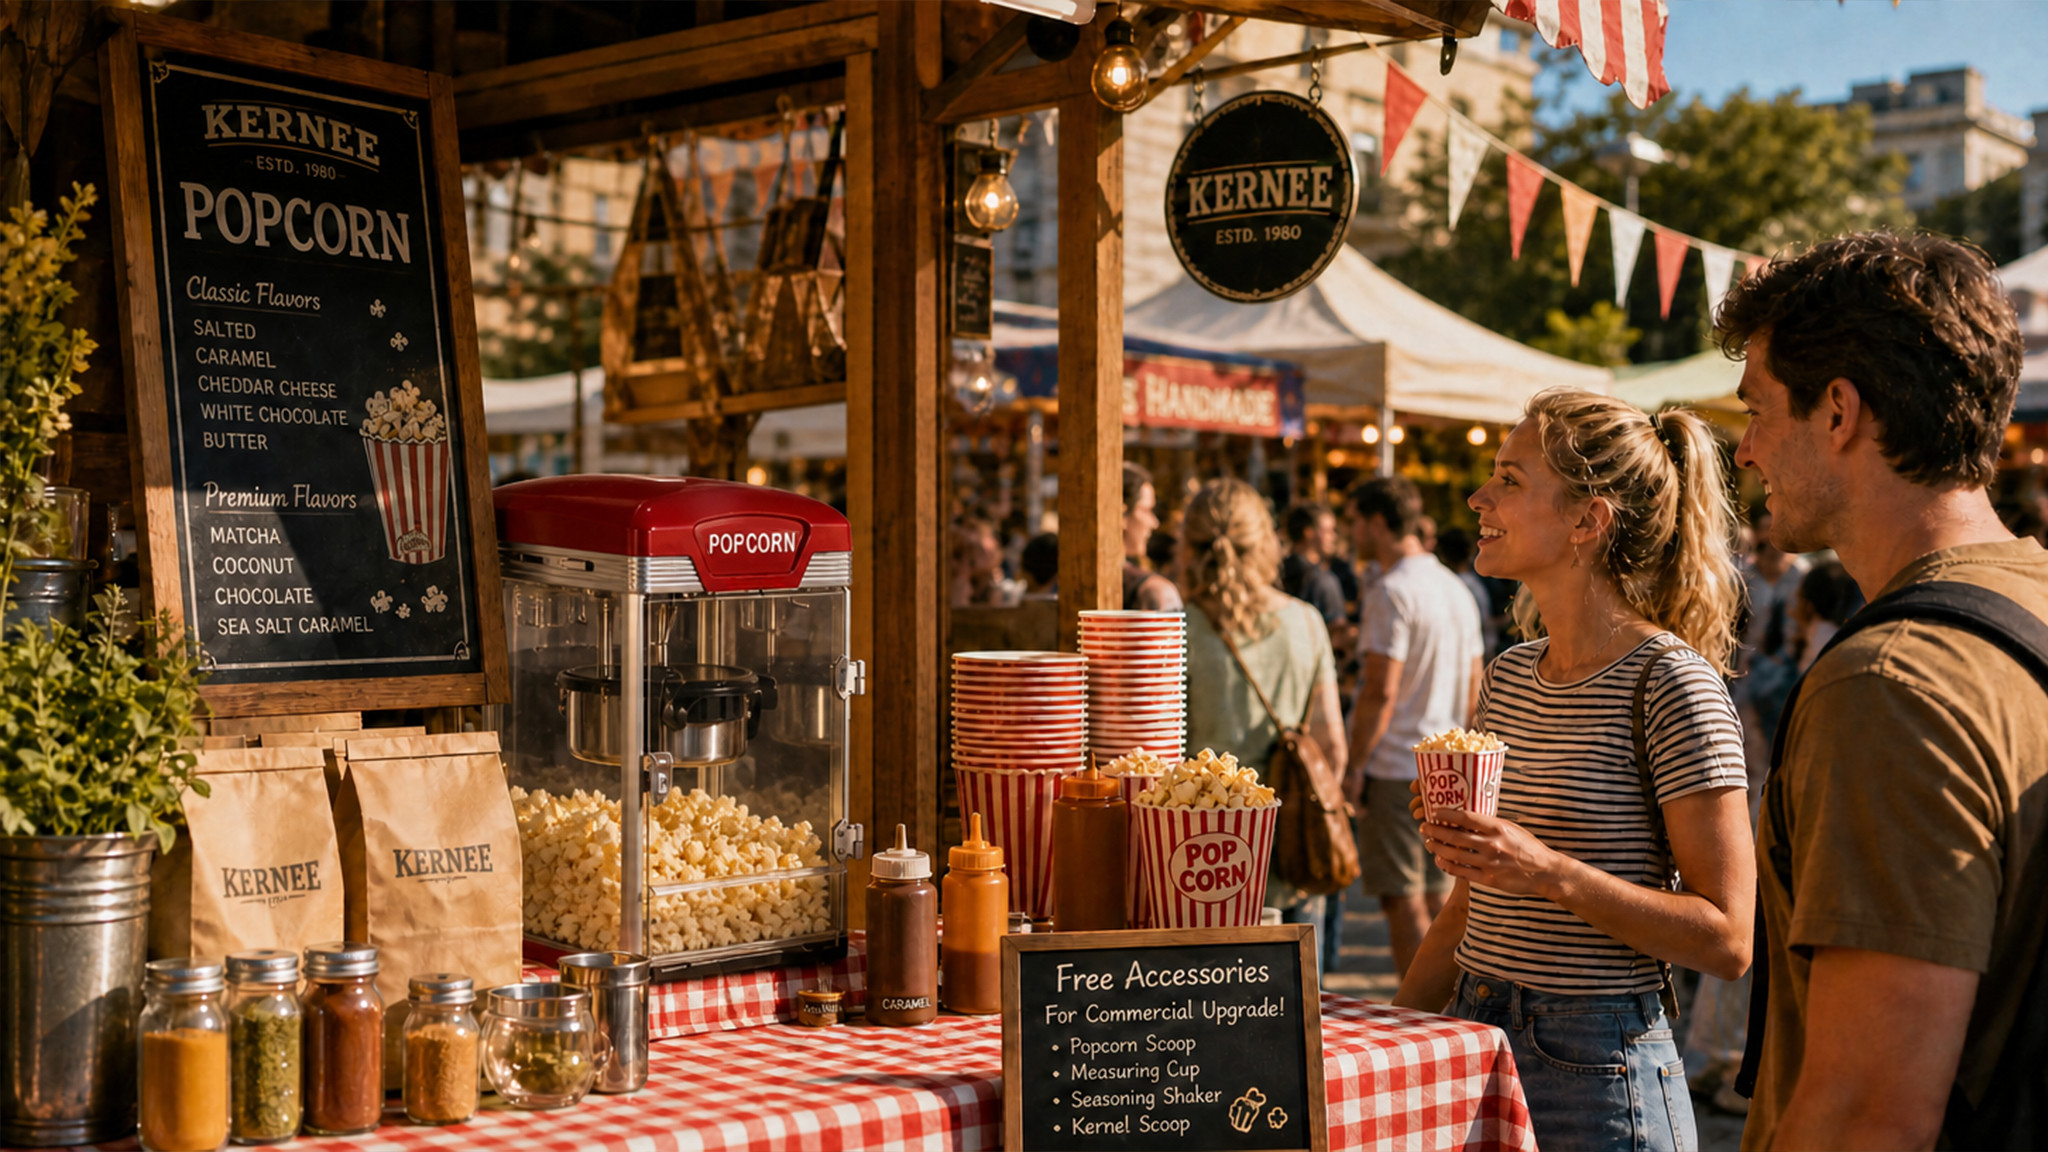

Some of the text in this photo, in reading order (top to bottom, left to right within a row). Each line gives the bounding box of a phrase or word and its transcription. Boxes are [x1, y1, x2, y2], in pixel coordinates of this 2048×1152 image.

[202, 103, 380, 167] KERNEE
[256, 156, 336, 180] ESTD. 1980
[1186, 165, 1334, 219] KERNEE
[180, 181, 411, 264] POPCORN
[1215, 224, 1302, 245] ESTD. 1980
[186, 275, 321, 311] Classic Flavors
[194, 319, 256, 340] SALTED
[196, 347, 277, 369] CARAMEL
[198, 375, 337, 399] CHEDDAR CHEESE
[201, 404, 349, 426] WHITE CHOCOLATE
[203, 432, 269, 451] BUTTER
[203, 481, 357, 510] Premium Flavors
[211, 527, 282, 545] MATCHA
[708, 532, 796, 555] POPCORN
[213, 557, 295, 575] COCONUT
[215, 588, 314, 605] CHOCOLATE
[218, 616, 374, 636] SEA SALT CARAMEL
[1429, 774, 1459, 790] POP
[1427, 788, 1465, 806] CORN
[393, 843, 493, 878] KERNEE
[1185, 840, 1237, 868] POP
[221, 860, 322, 898] KERNEE
[1180, 860, 1246, 893] CORN
[1056, 958, 1270, 993] Free Accessories
[882, 997, 931, 1010] CARAMEL
[1045, 997, 1285, 1026] For Commercial Upgrade!
[1070, 1034, 1196, 1059] Popcorn Scoop
[1071, 1059, 1200, 1083] Measuring Cup
[1071, 1084, 1222, 1110] Seasoning Shaker
[1072, 1115, 1191, 1136] Kernel Scoop
